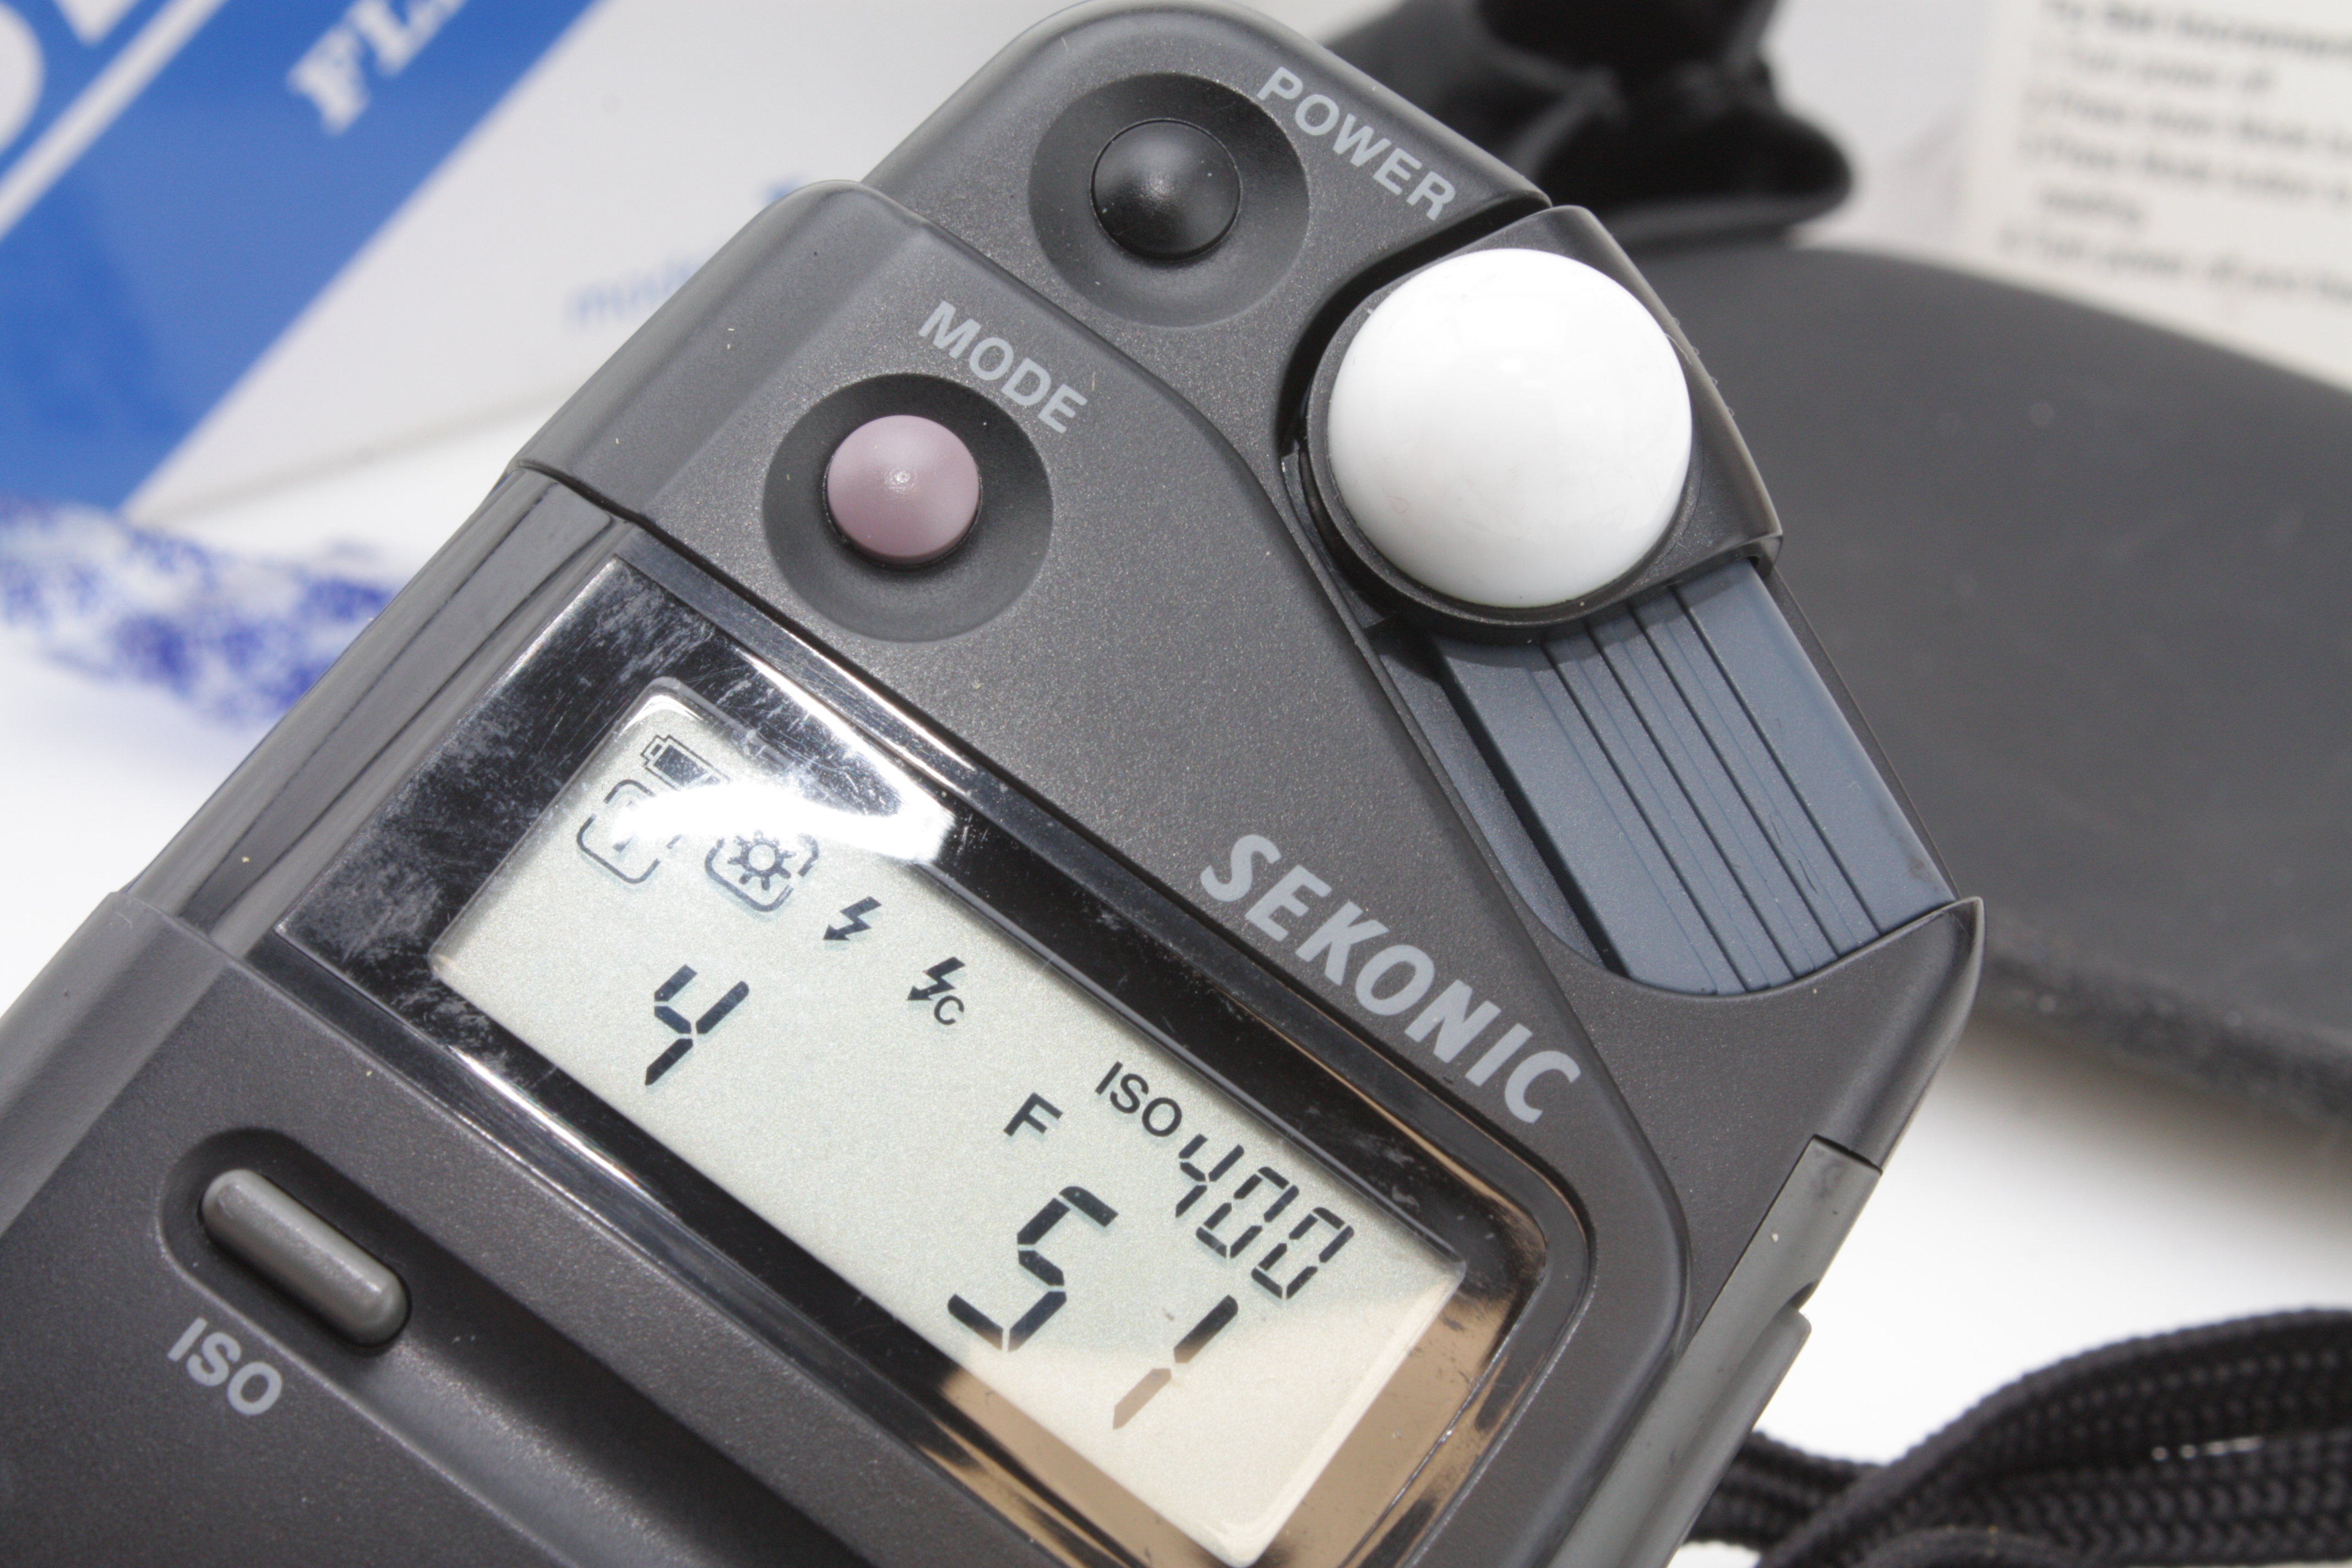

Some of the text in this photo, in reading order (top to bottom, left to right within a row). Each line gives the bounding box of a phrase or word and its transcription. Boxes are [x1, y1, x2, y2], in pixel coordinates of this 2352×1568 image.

[1257, 66, 1456, 221] POWER
[918, 300, 1088, 434] MODE
[645, 964, 750, 1086] 4
[1200, 834, 1582, 1124] SEKONIC
[1003, 1092, 1063, 1137] F
[1095, 1061, 1354, 1300] ISO 400
[167, 1317, 282, 1415] ISO
